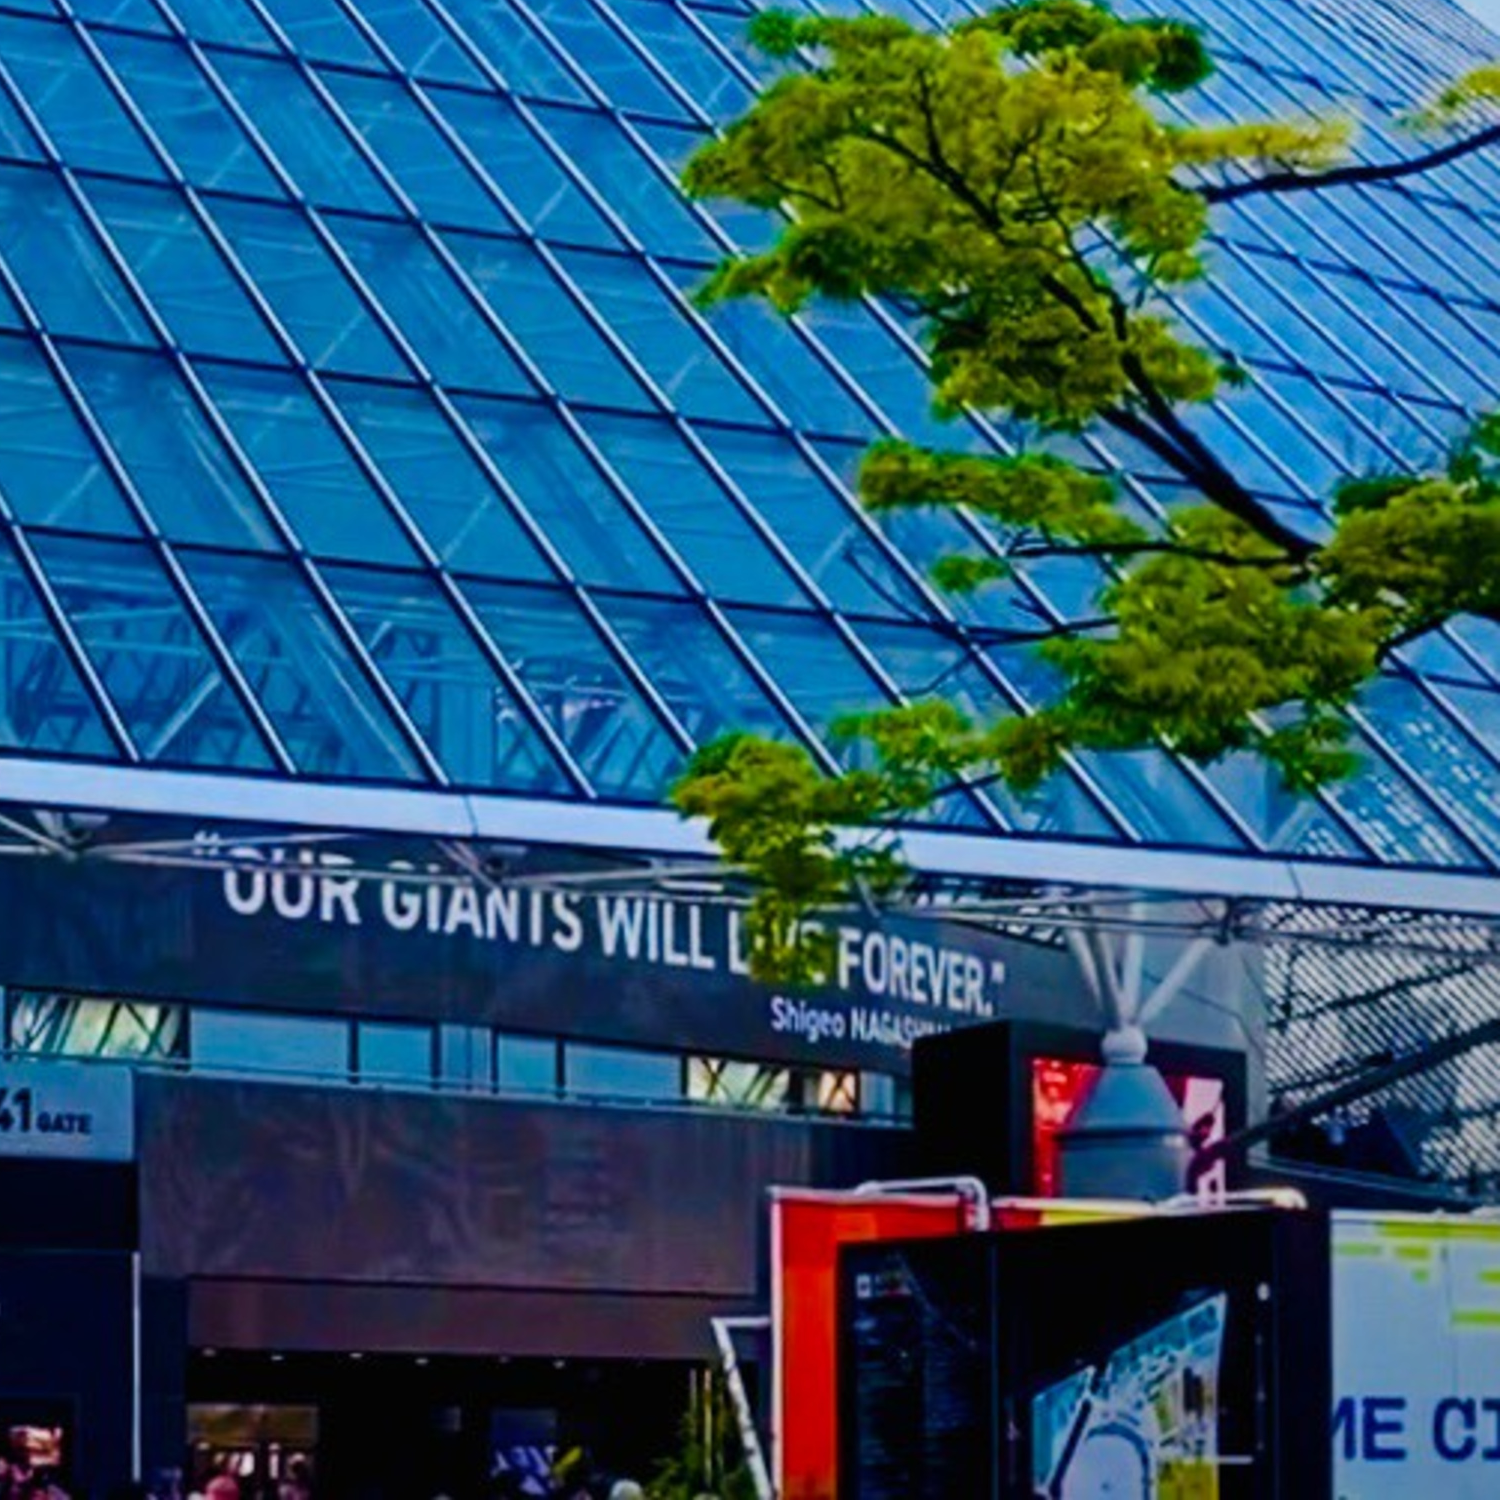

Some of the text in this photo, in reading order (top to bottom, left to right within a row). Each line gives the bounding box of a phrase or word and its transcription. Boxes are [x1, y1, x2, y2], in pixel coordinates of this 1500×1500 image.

[382, 860, 583, 951] GIANTS
[597, 898, 715, 969] WILL
[770, 995, 846, 1043] Shigeo
[37, 1111, 93, 1135] GATE
